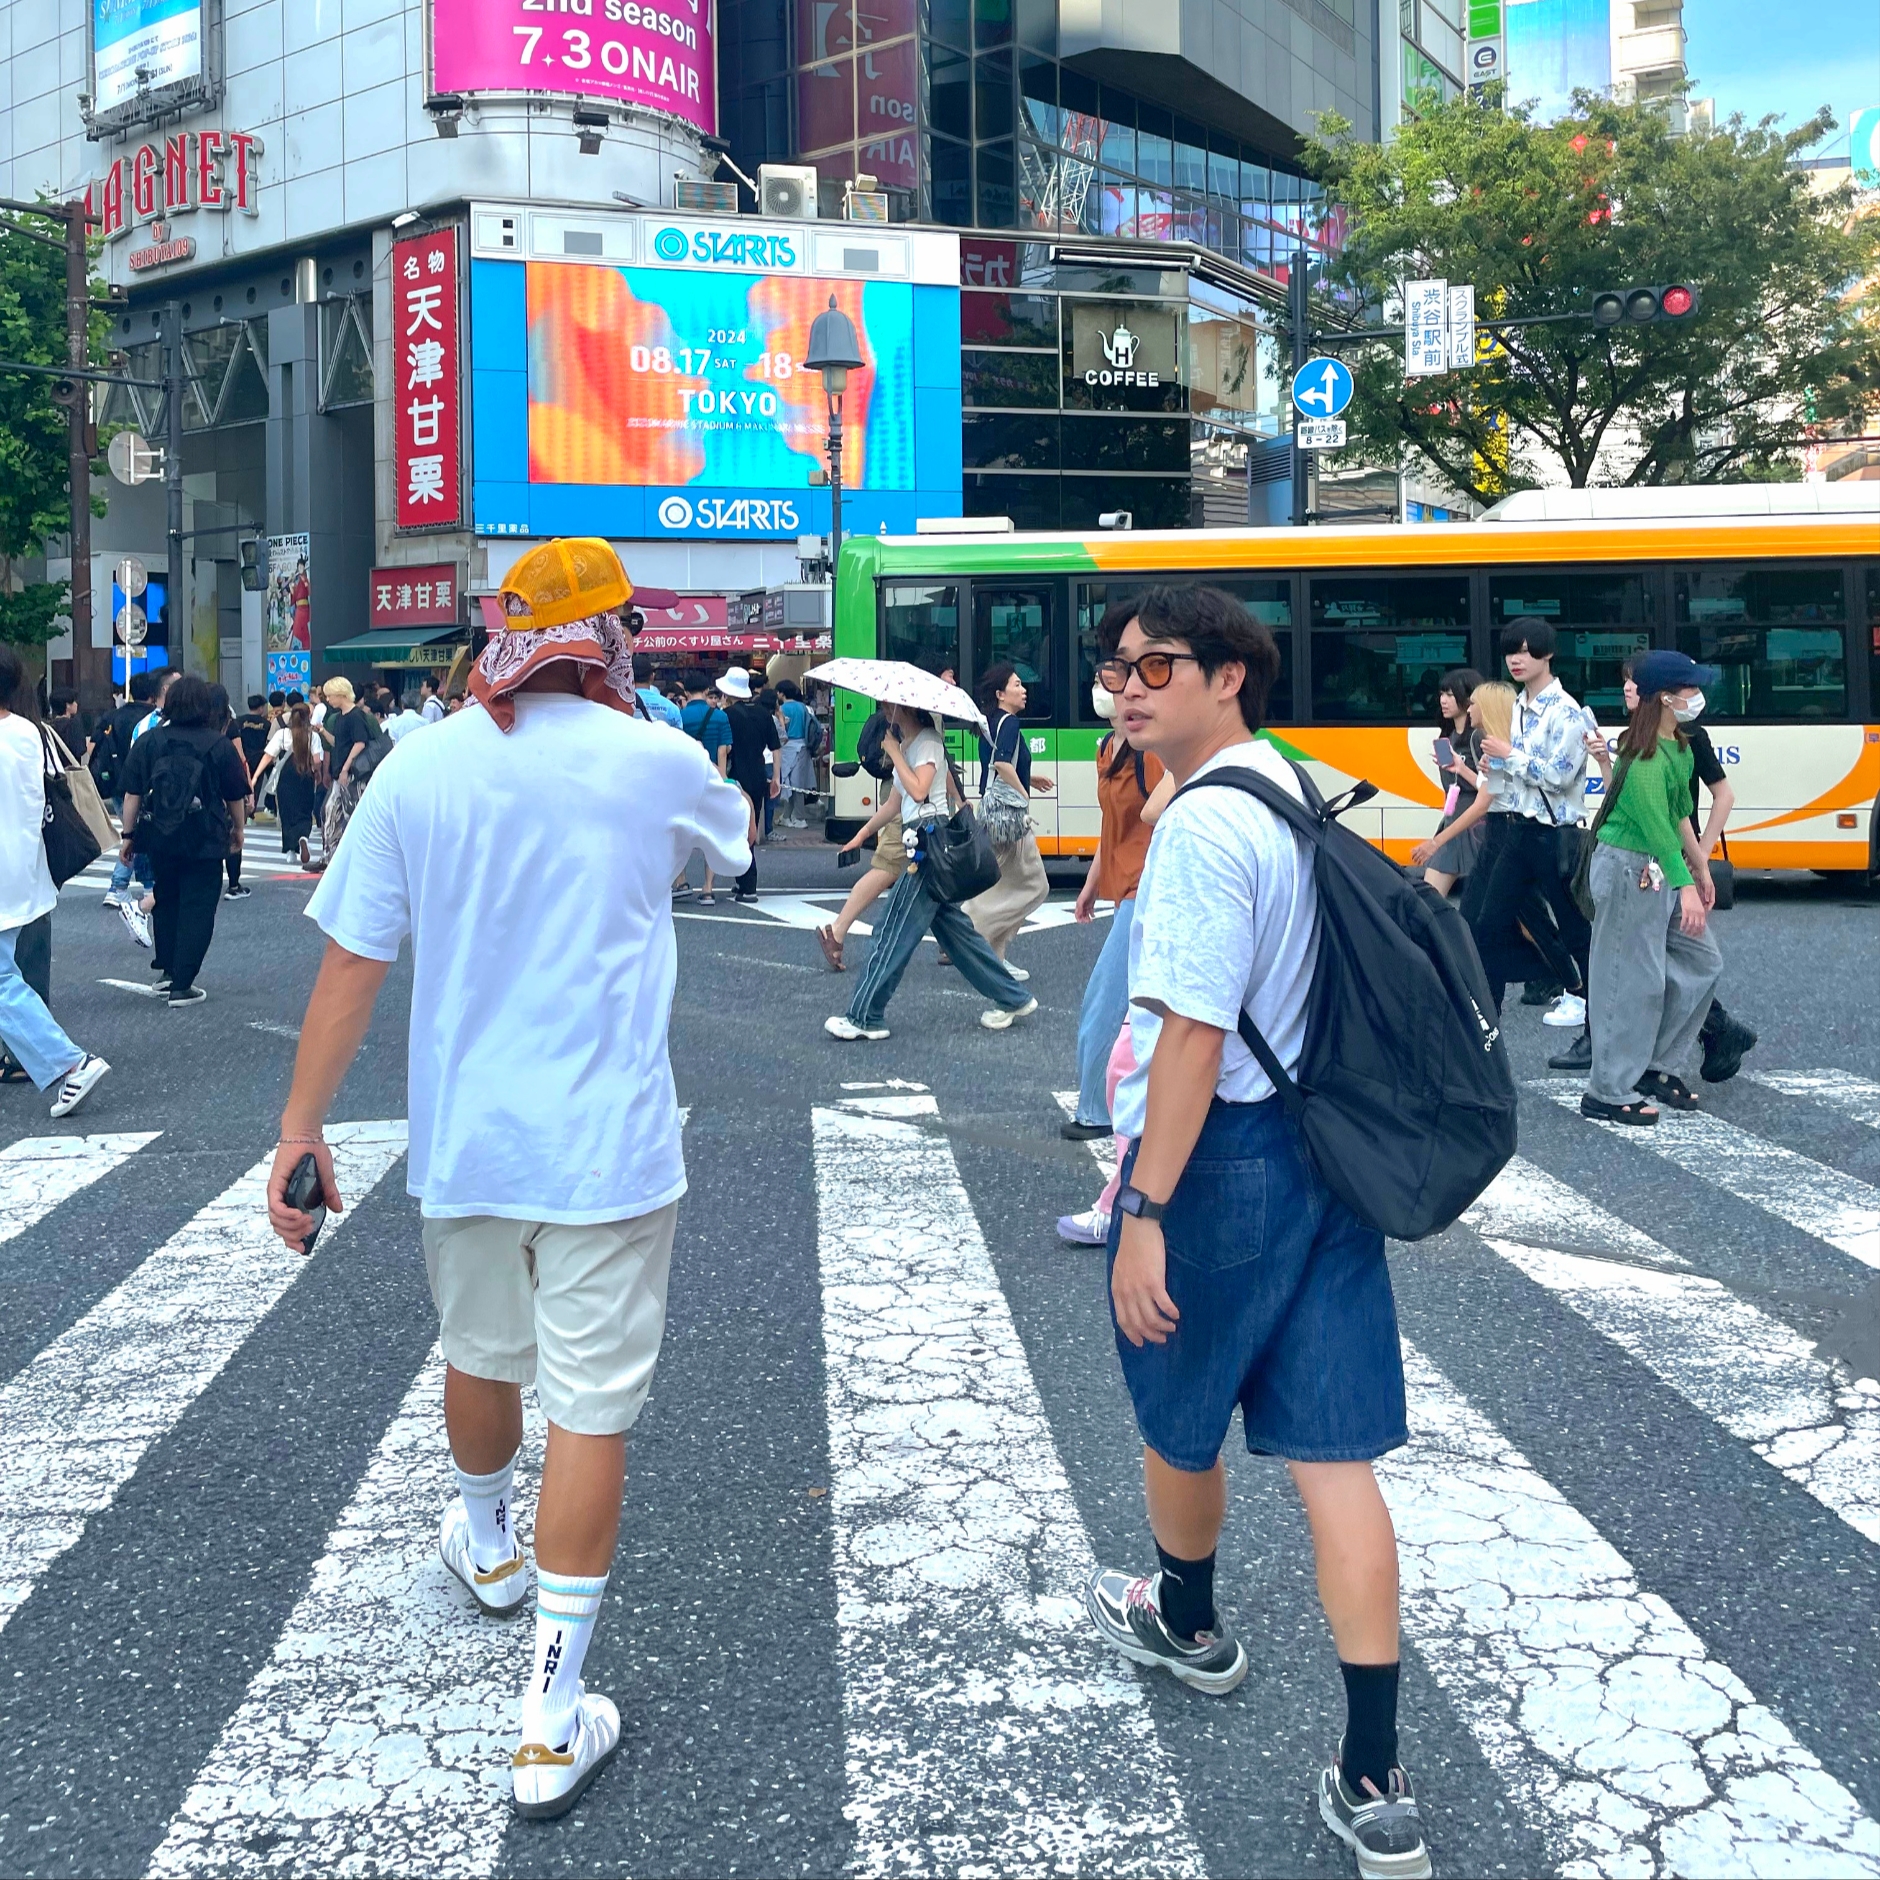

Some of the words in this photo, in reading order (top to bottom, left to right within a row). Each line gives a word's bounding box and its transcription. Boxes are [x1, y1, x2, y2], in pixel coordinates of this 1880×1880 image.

[605, 0, 697, 50] season
[151, 221, 165, 241] by
[129, 238, 190, 271] SHIBUYA109
[404, 248, 446, 280] 名物
[1411, 301, 1421, 337] Shibuya
[1424, 288, 1441, 367] 渋谷駅前
[1455, 289, 1469, 364] スクランブル式
[707, 329, 746, 345] 2024
[629, 346, 712, 375] 08.17
[714, 358, 737, 369] SAT
[759, 352, 793, 379] 18
[1085, 369, 1160, 388] COFFEE
[406, 284, 446, 505] 天津甘栗
[677, 389, 777, 416] TOKYO
[691, 419, 734, 431] STADIUM
[475, 523, 530, 534] 三千里薬品
[696, 497, 799, 532] STARTS
[267, 537, 284, 549] ONE
[285, 535, 309, 547] PIECE
[376, 581, 452, 611] 天津甘栗
